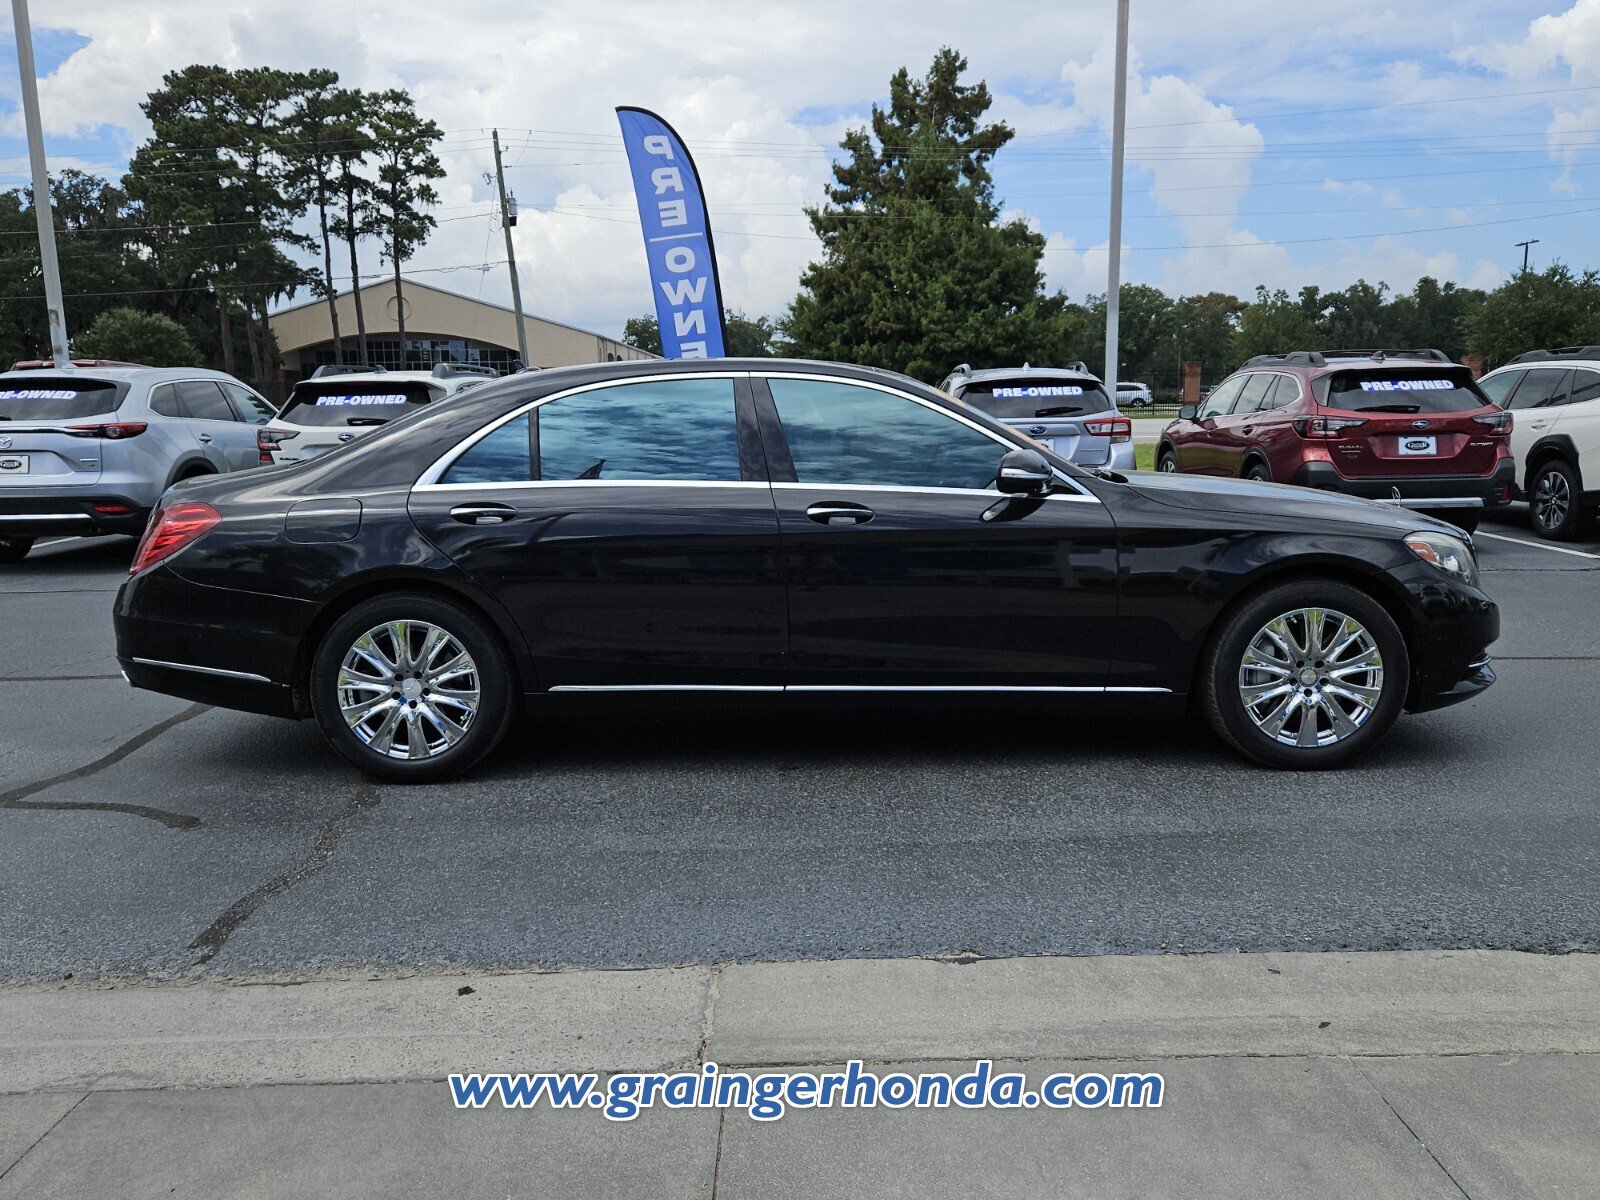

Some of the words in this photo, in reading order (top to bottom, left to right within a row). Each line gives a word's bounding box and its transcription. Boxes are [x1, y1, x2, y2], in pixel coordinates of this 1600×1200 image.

[1359, 380, 1455, 391] PRE-OWNED
[992, 386, 1084, 397] PRE-OWNED
[315, 394, 408, 406] PRE-OWNED
